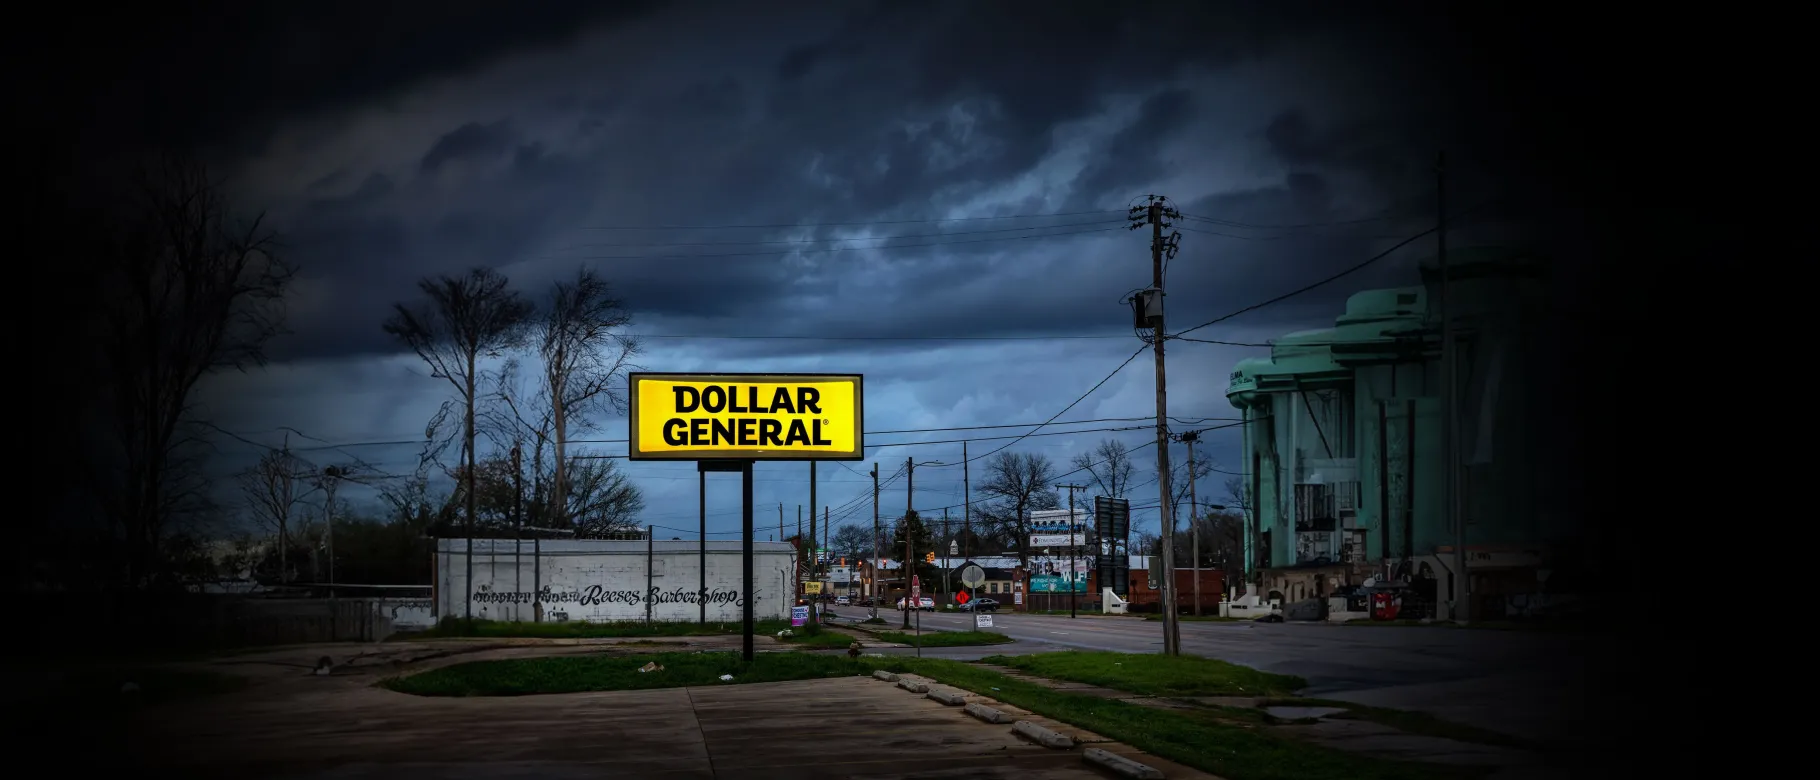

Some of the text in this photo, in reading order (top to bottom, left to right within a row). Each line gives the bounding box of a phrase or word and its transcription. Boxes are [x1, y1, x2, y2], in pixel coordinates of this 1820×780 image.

[672, 385, 822, 414] DOLLAR
[662, 418, 832, 446] GENERAL
[580, 585, 640, 605] Reeses
[642, 586, 698, 606] Barber
[697, 587, 738, 608] Shop
